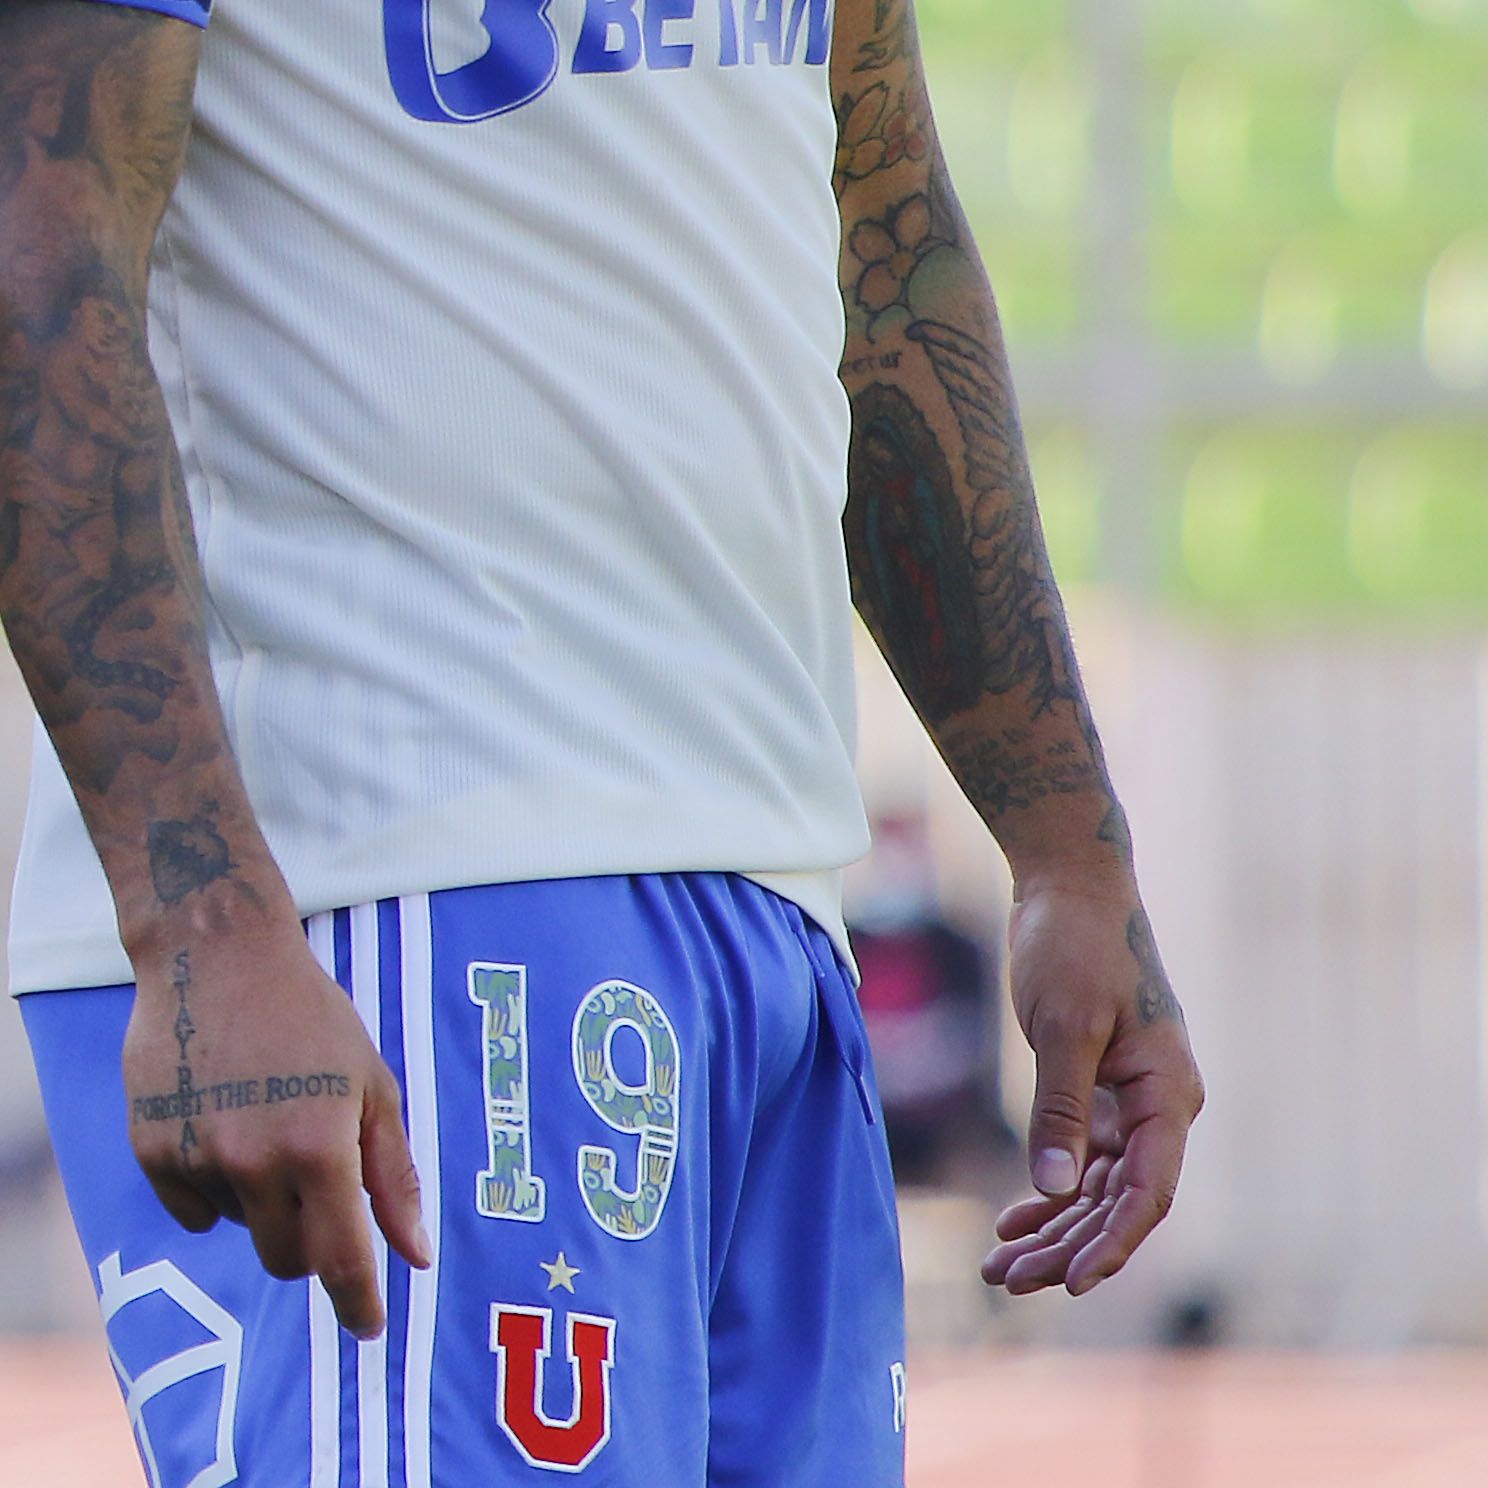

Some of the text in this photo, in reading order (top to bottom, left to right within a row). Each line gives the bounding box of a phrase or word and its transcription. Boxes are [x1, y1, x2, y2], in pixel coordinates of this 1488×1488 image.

[210, 1077, 260, 1112] THE
[264, 1071, 352, 1104] ROOTS
[466, 961, 682, 1242] 19
[488, 1302, 618, 1474] U
